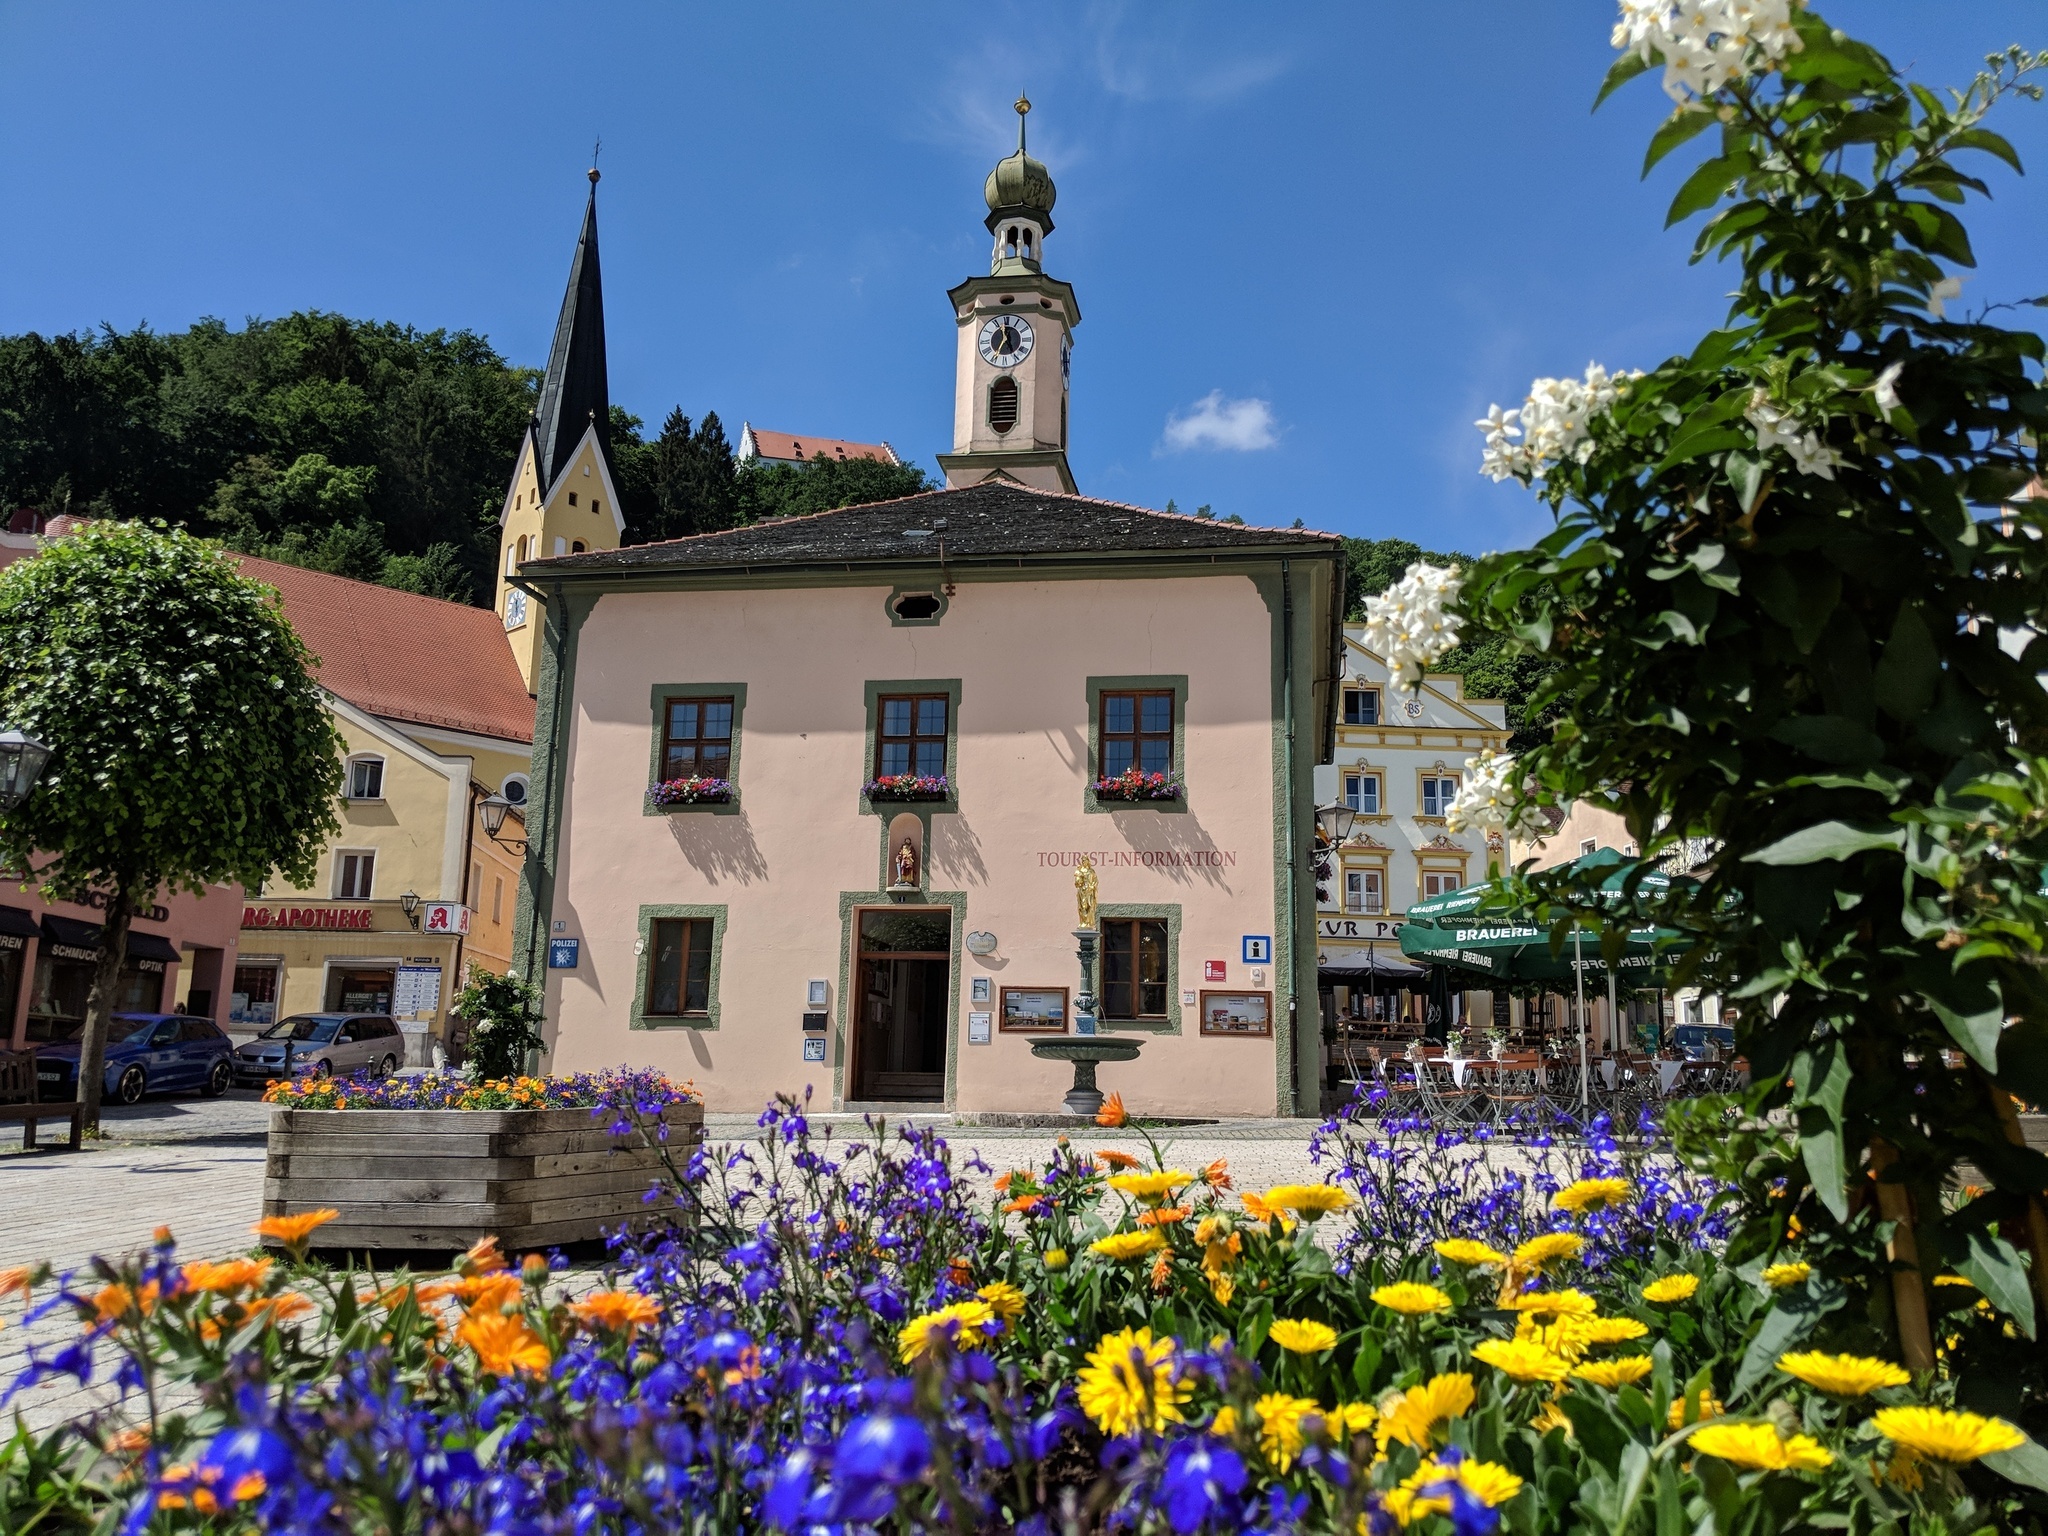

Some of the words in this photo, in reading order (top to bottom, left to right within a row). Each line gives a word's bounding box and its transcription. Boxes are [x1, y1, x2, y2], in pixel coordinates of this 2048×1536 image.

[1037, 852, 1237, 867] TOURST-INFORMATION
[242, 907, 371, 928] RG-APOTHEKE
[1456, 927, 1538, 942] BRAUEREI
[551, 940, 578, 948] POLIZEI
[51, 944, 98, 962] SCHMUCK
[139, 959, 164, 973] OPTIK
